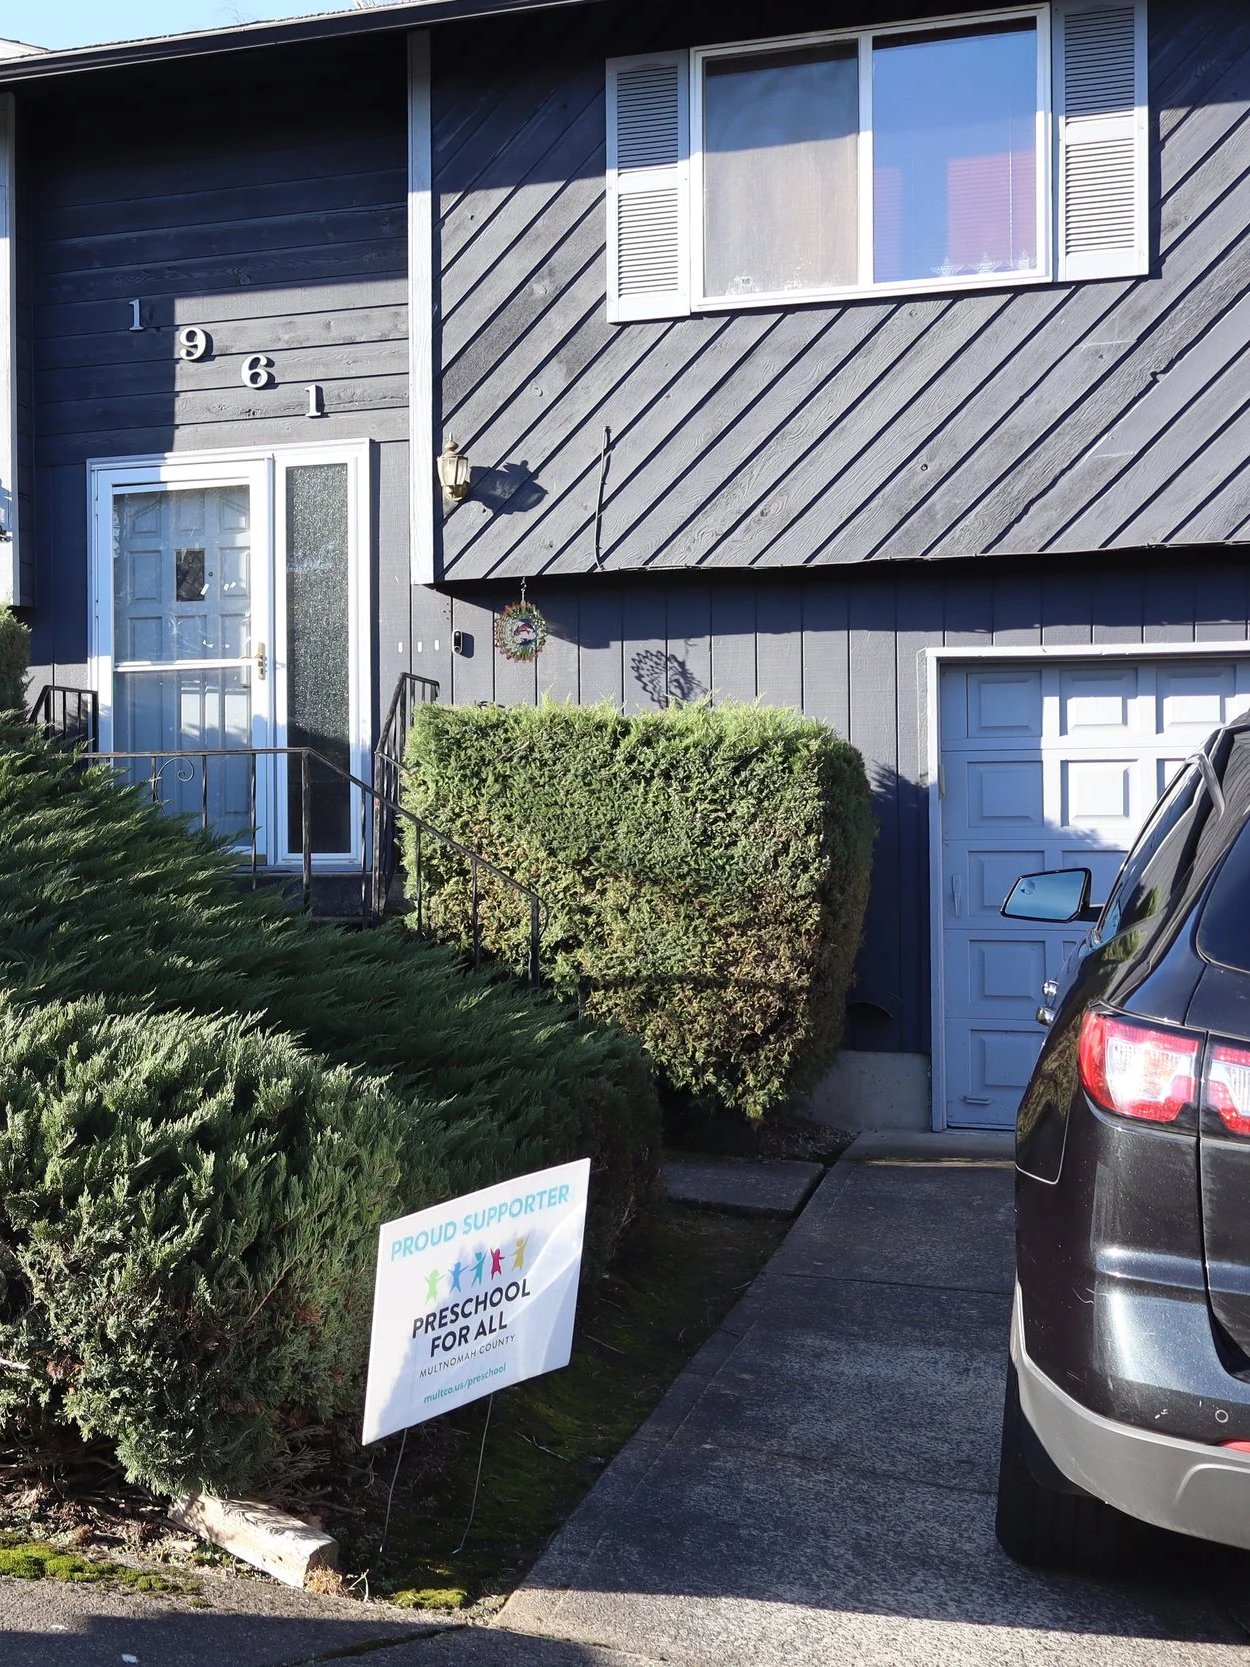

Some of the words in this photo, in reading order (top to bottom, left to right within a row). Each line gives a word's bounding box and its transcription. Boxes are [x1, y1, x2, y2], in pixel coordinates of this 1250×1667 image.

[129, 299, 323, 417] 1961
[391, 1221, 457, 1261] PROUD
[462, 1184, 570, 1235] SUPPORTER
[412, 1278, 530, 1339] PRESCHOOL
[430, 1325, 470, 1358] FOR
[474, 1311, 507, 1341] ALL
[419, 1348, 476, 1379] MULTNOMAH
[479, 1334, 516, 1355] COUNTY
[423, 1362, 507, 1404] multco.us/preschool
